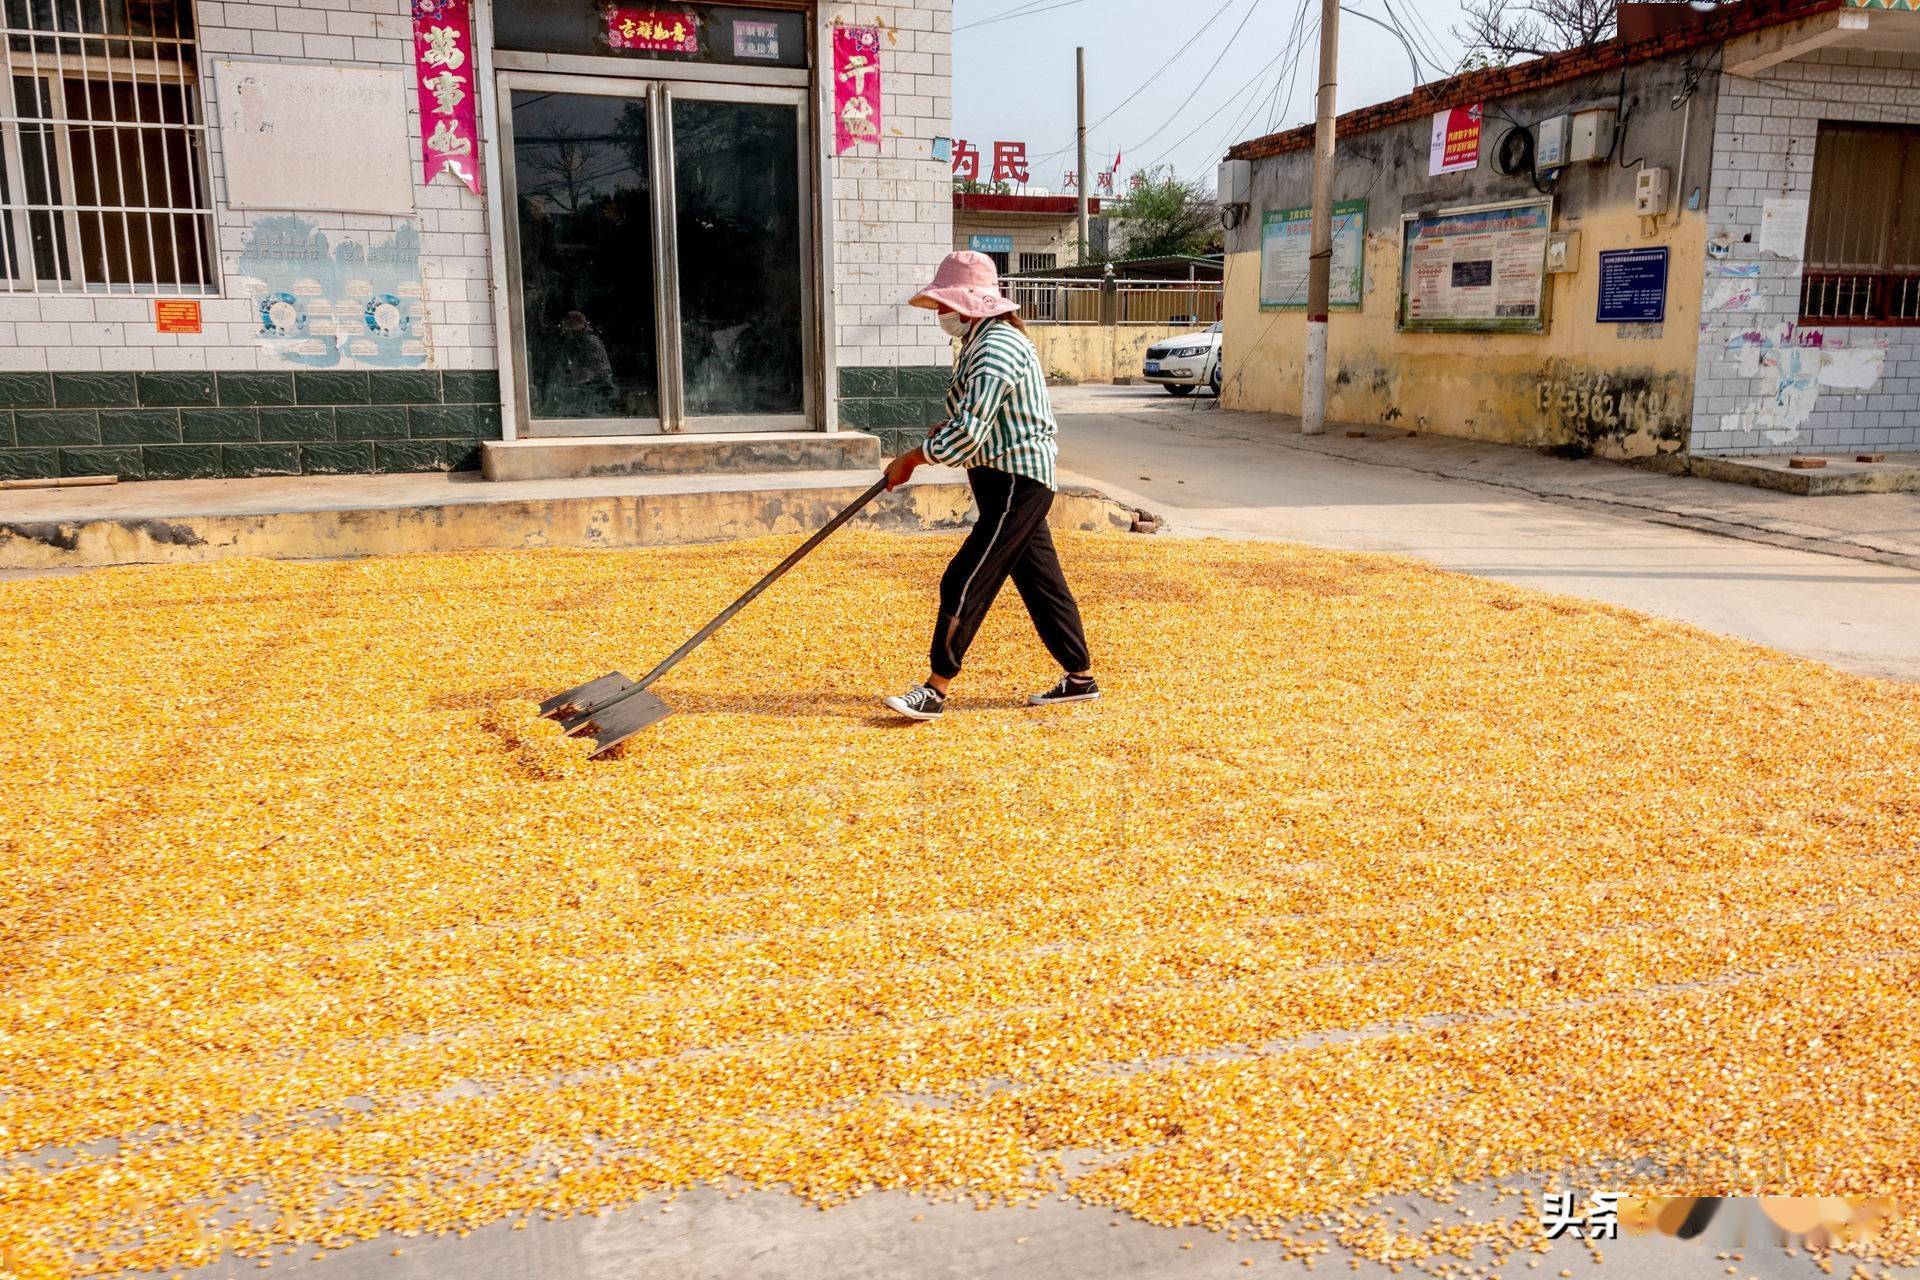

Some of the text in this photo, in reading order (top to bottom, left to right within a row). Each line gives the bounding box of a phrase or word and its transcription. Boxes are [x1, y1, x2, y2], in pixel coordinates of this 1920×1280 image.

[618, 18, 686, 42] 吉祥如意
[952, 139, 1030, 184] 为民
